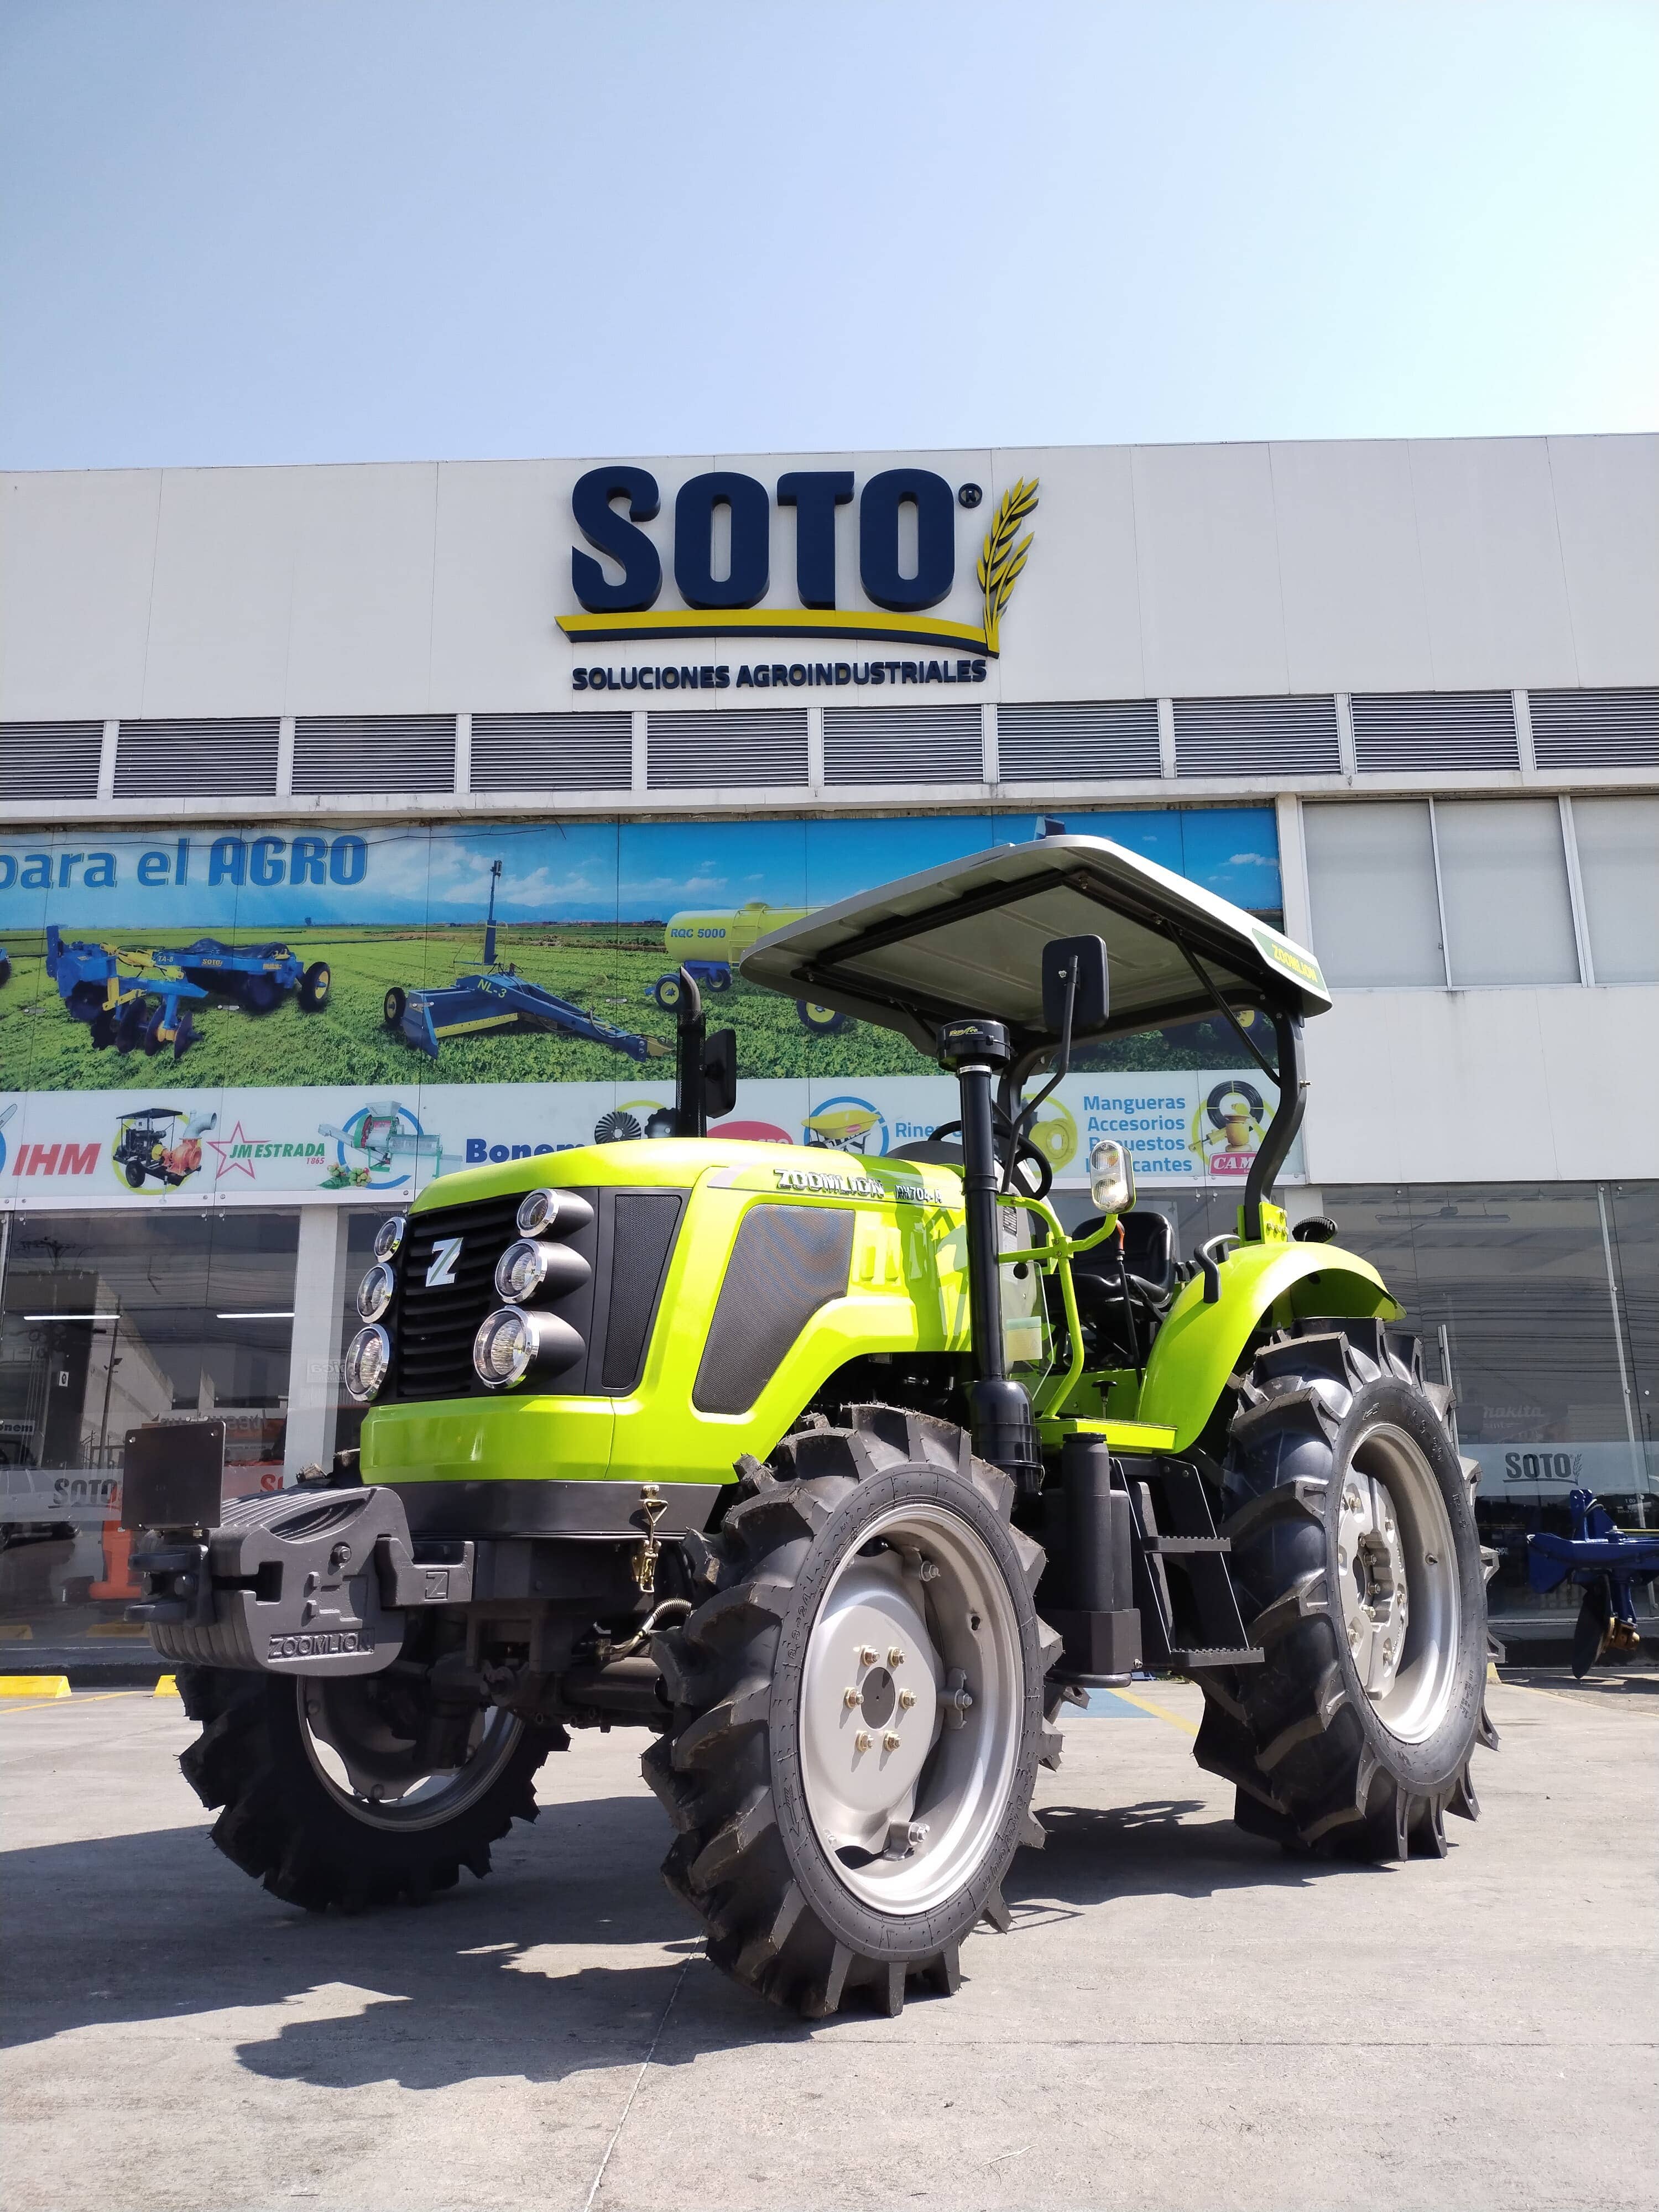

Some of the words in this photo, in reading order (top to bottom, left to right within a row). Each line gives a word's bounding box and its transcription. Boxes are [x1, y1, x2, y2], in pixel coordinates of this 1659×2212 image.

[572, 466, 955, 613] SOTO
[572, 665, 731, 691] SOLUCIONES
[737, 659, 987, 688] AGROINDUSTRIALES
[138, 838, 190, 887] el
[208, 836, 368, 887] AGRO
[671, 928, 693, 938] RQC
[697, 928, 726, 938] 5000
[1271, 943, 1318, 983] ZOOMLION
[477, 978, 507, 998] NL-3
[1083, 1096, 1186, 1114] Mangueras
[895, 1122, 940, 1138] Rine
[1087, 1115, 1185, 1131] Accesorios
[12, 1143, 102, 1176] IHM
[229, 1144, 253, 1159] JM
[254, 1142, 325, 1158] ESTRADA
[306, 1157, 325, 1165] 1865
[774, 1168, 884, 1199] ZOOMLION
[1505, 1452, 1572, 1479] SOTO
[53, 1478, 118, 1505] SOTO
[269, 1630, 374, 1659] ZOOMLION
